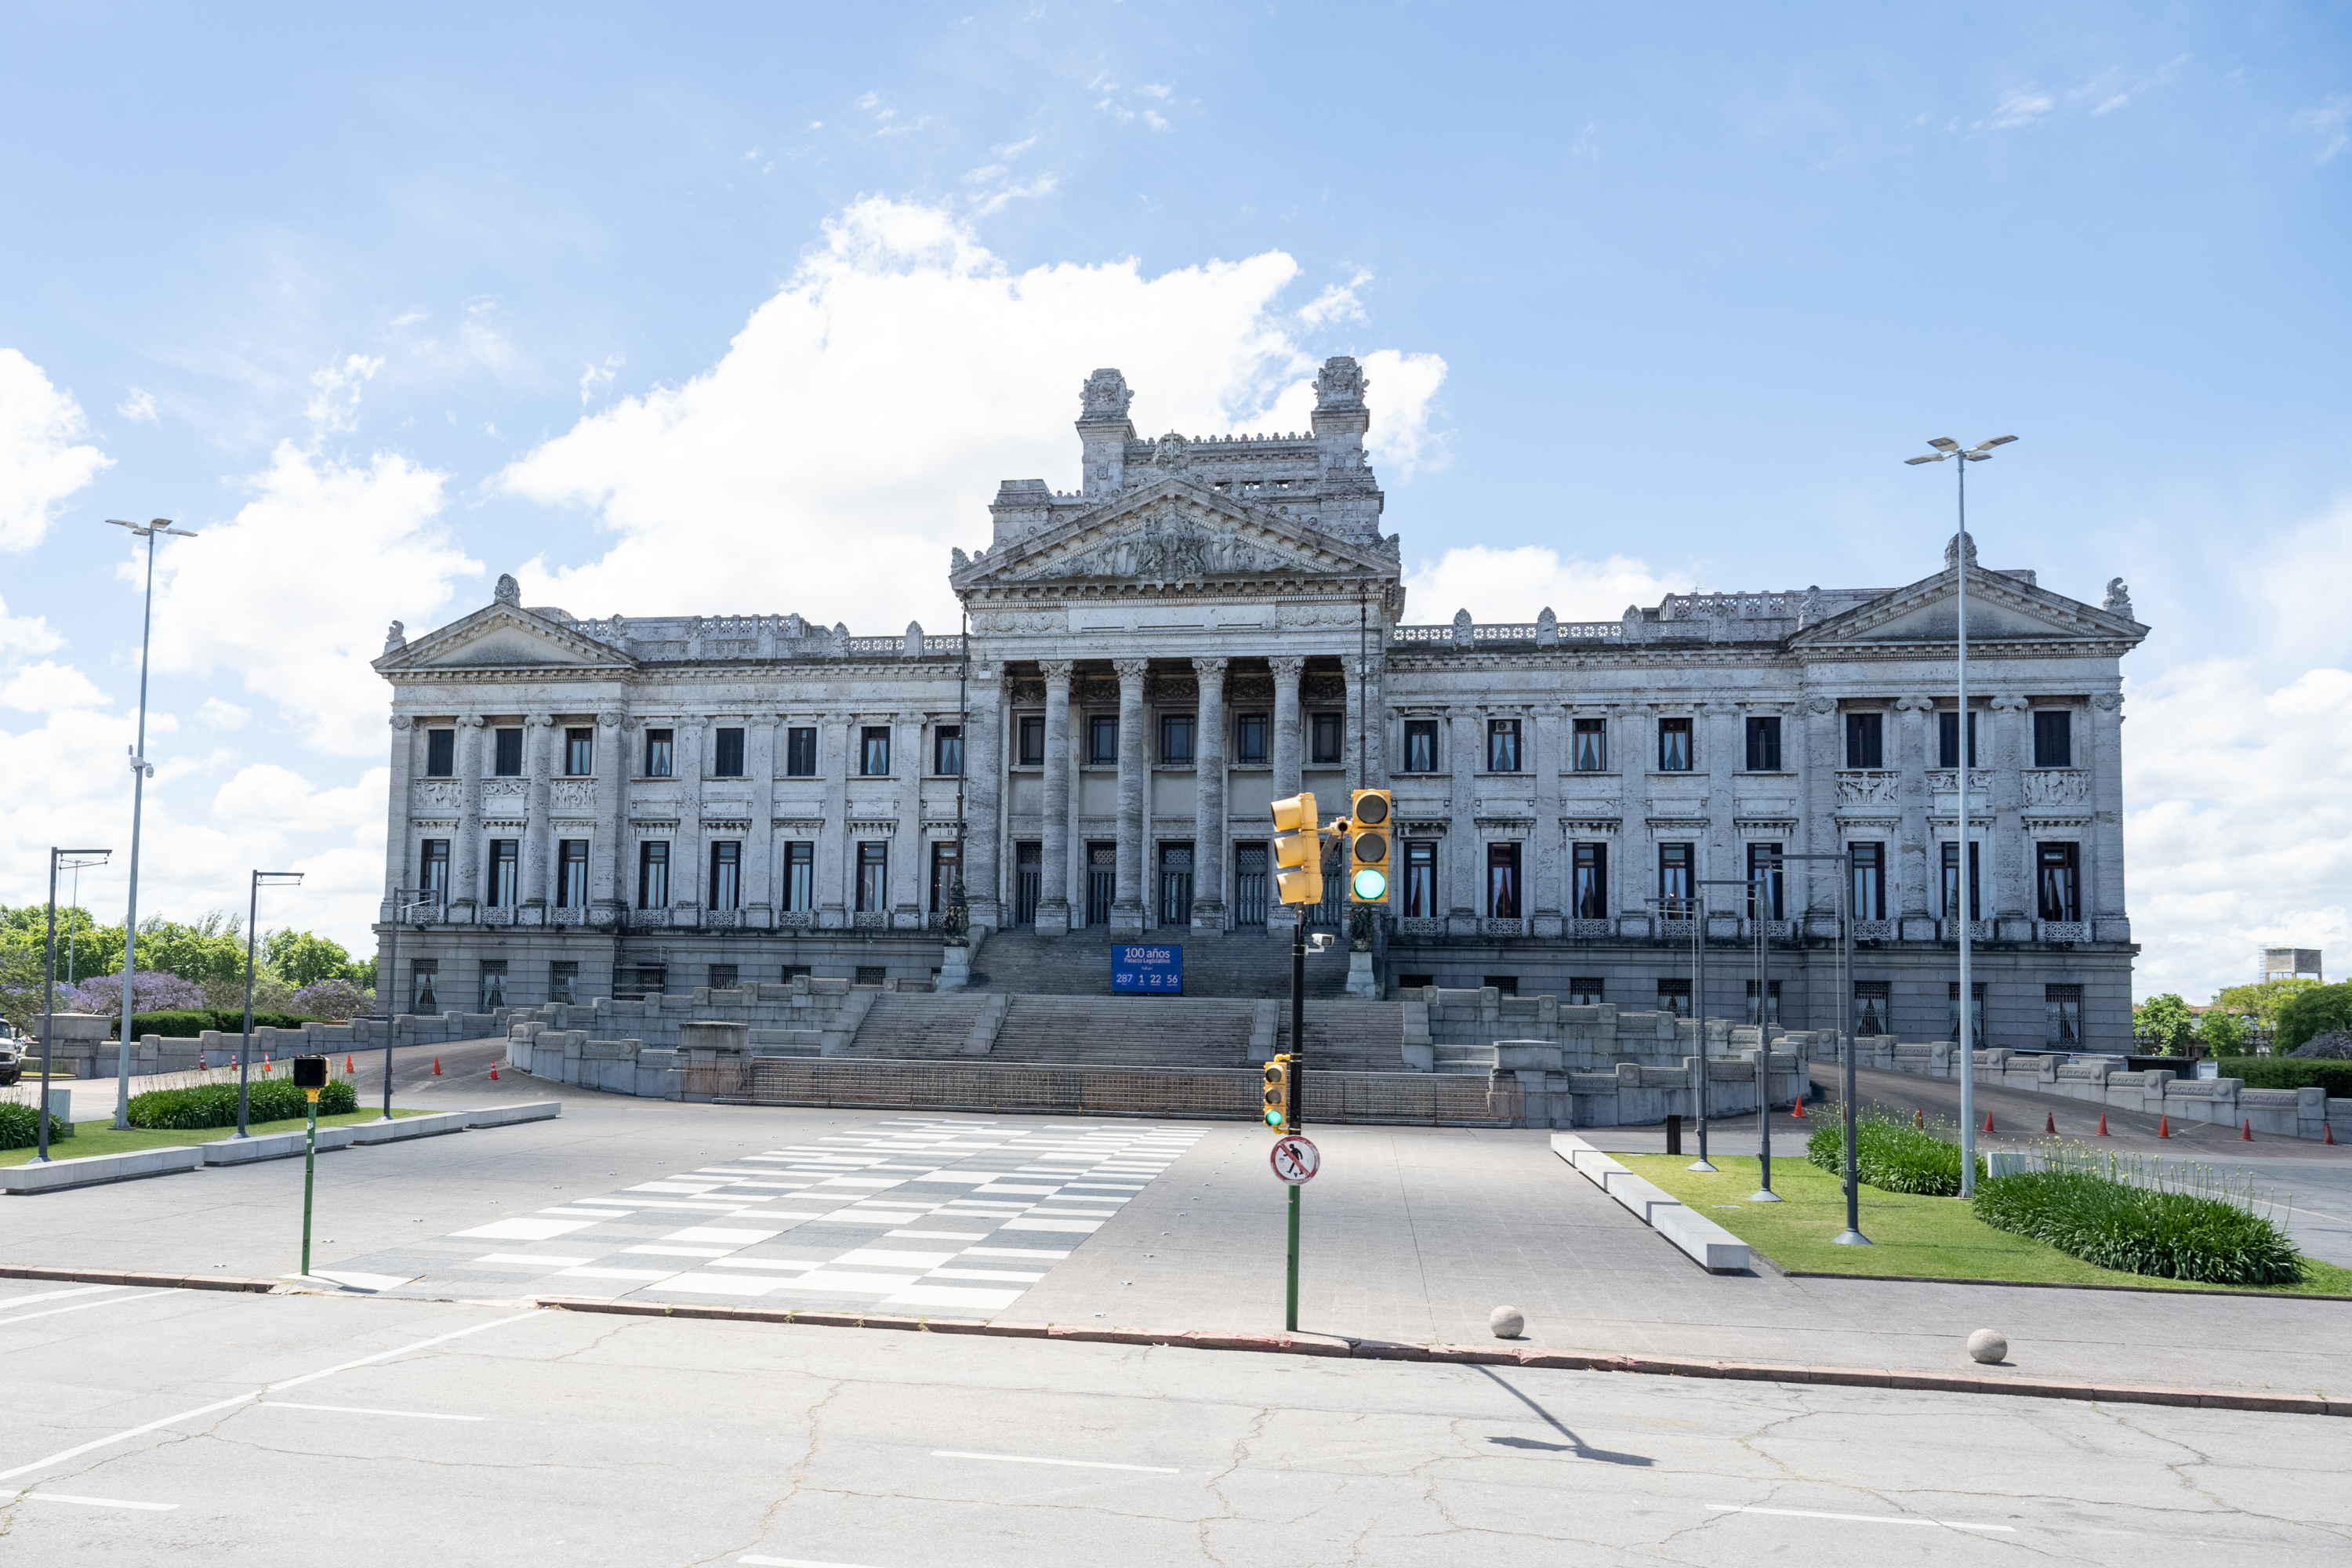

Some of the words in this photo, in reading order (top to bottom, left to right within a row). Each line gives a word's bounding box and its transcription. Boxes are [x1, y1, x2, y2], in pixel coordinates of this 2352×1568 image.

[1125, 948, 1145, 958] 100
[1146, 948, 1171, 958] años
[1116, 974, 1133, 983] 287
[1139, 975, 1145, 983] 1
[1150, 975, 1161, 983] 22
[1167, 975, 1178, 983] 56
